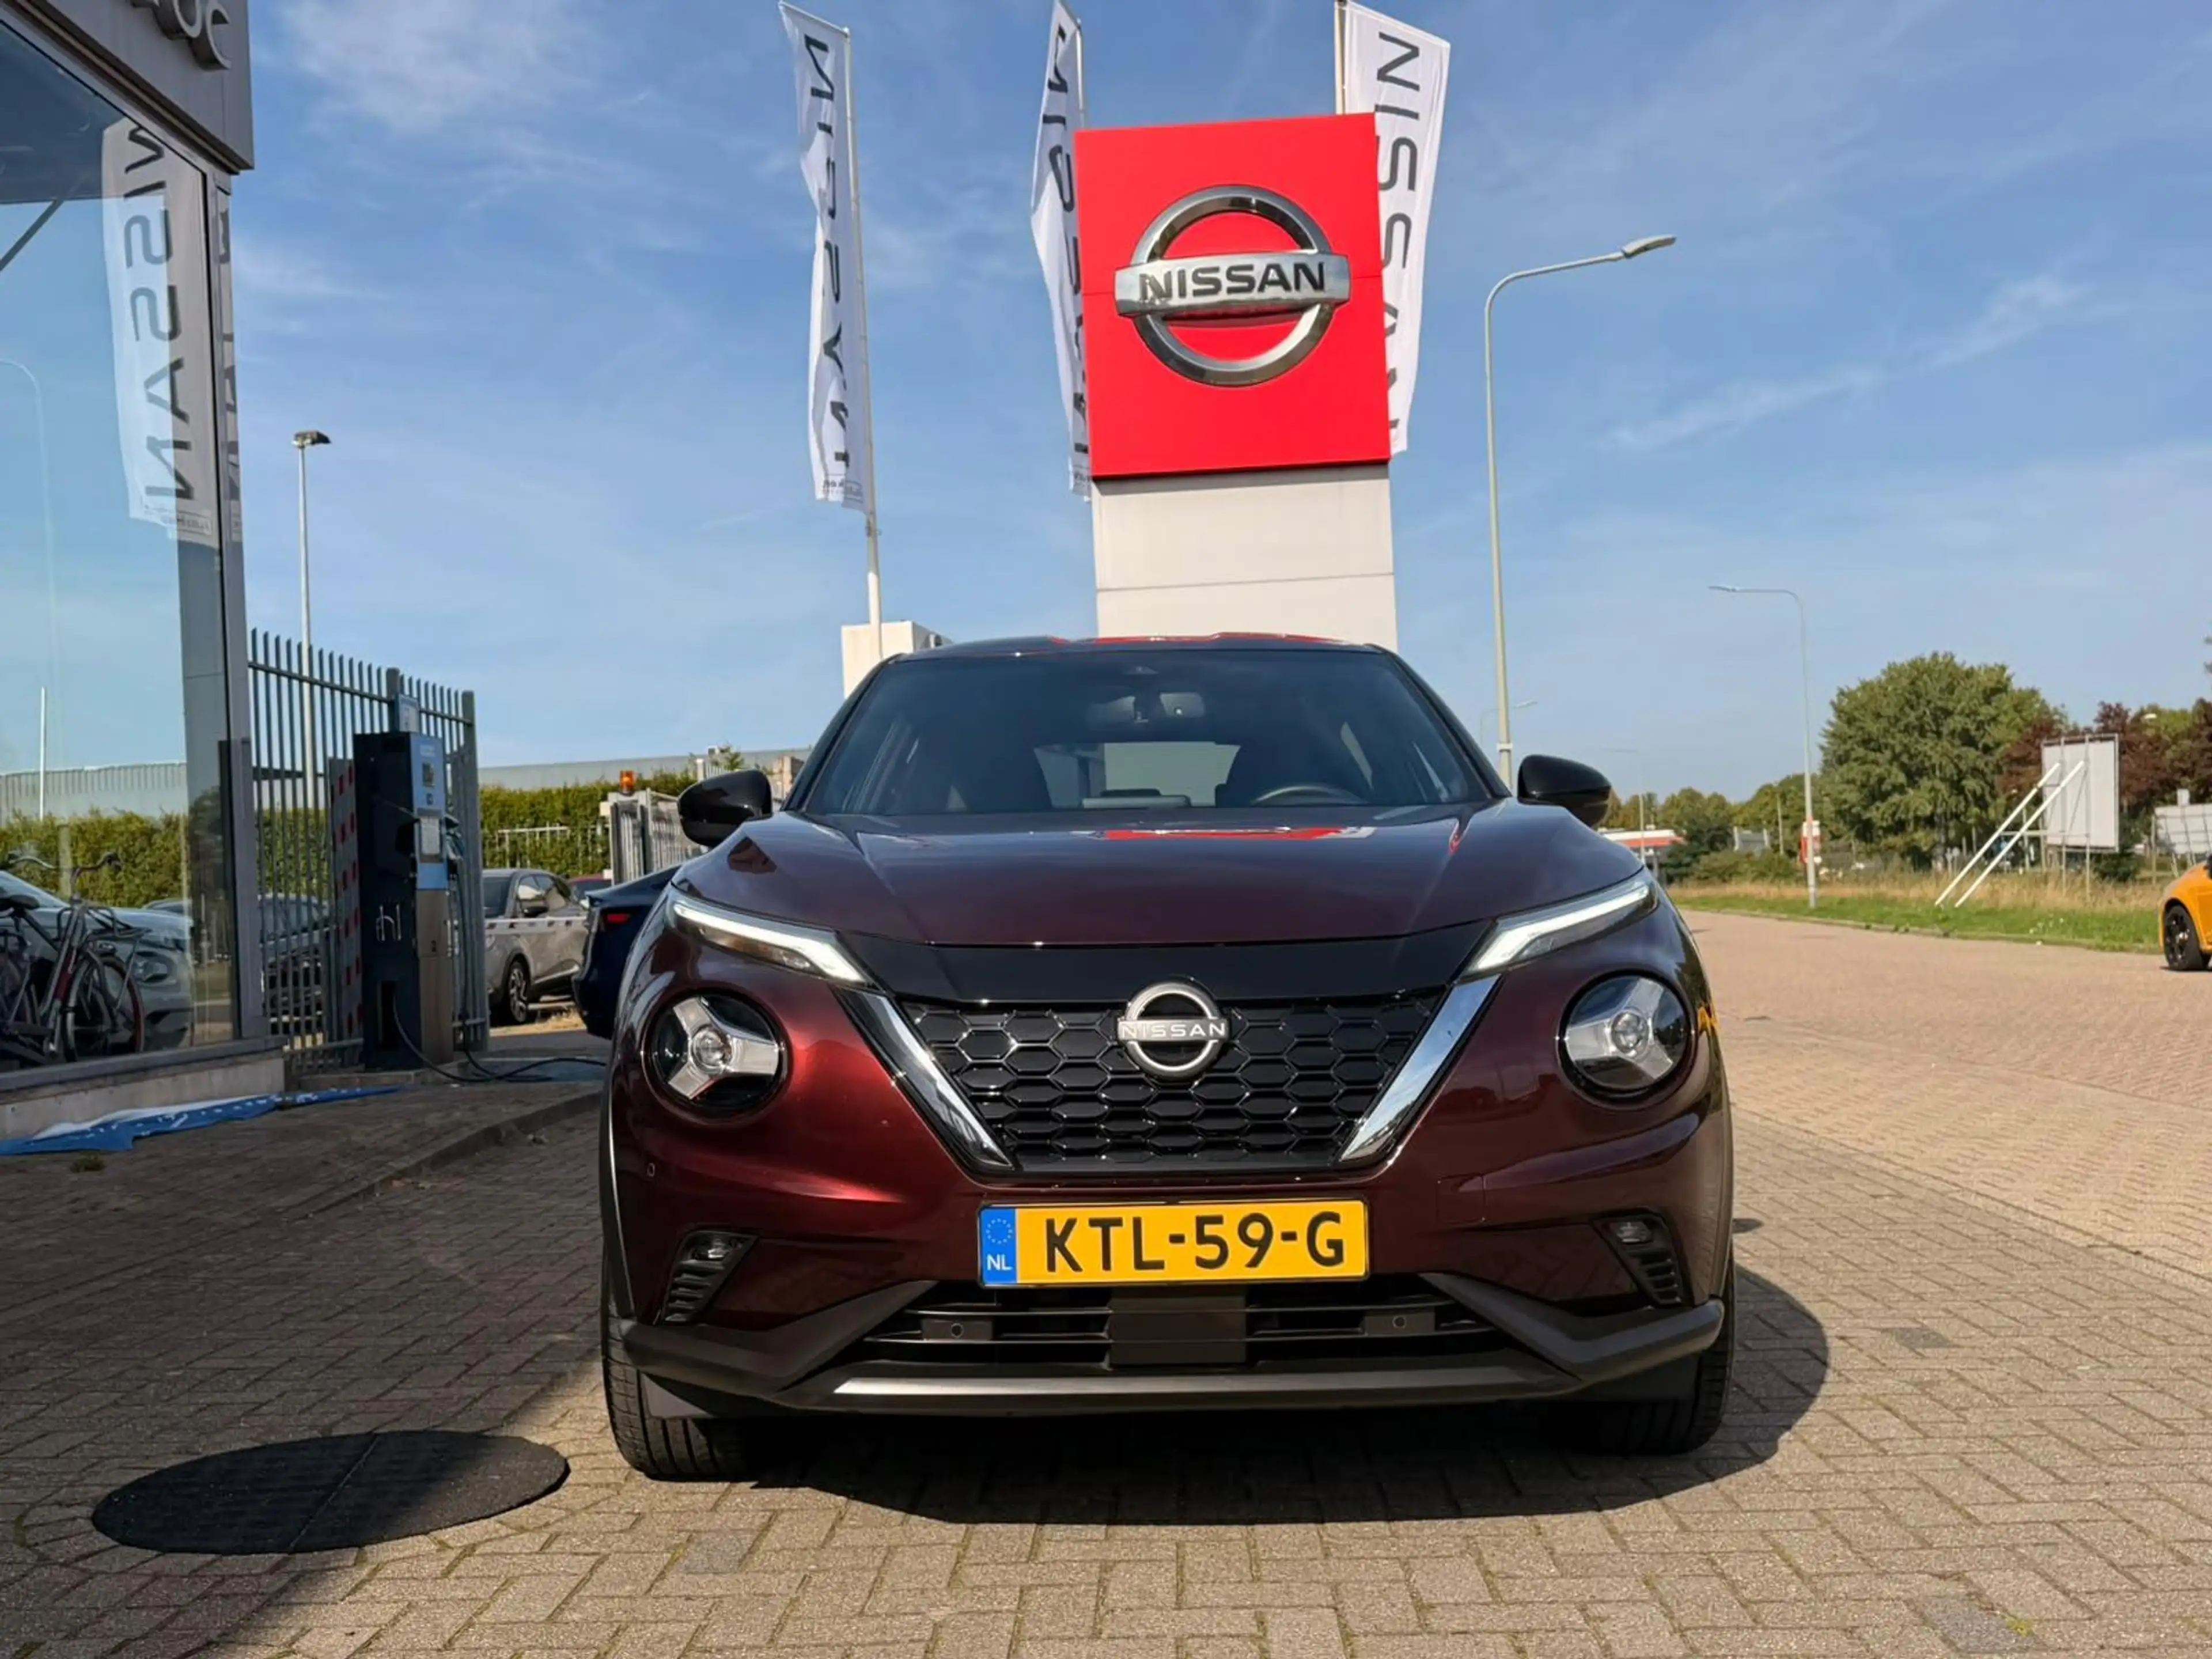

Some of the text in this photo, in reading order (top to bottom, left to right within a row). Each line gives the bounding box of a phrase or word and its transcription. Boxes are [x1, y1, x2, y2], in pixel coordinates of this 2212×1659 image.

[1374, 31, 1420, 429] NISS
[1139, 261, 1326, 302] NISSAN
[1122, 1022, 1226, 1038] NISSAN
[986, 1253, 1012, 1271] NL
[1044, 1211, 1345, 1272] KTL-59-G
